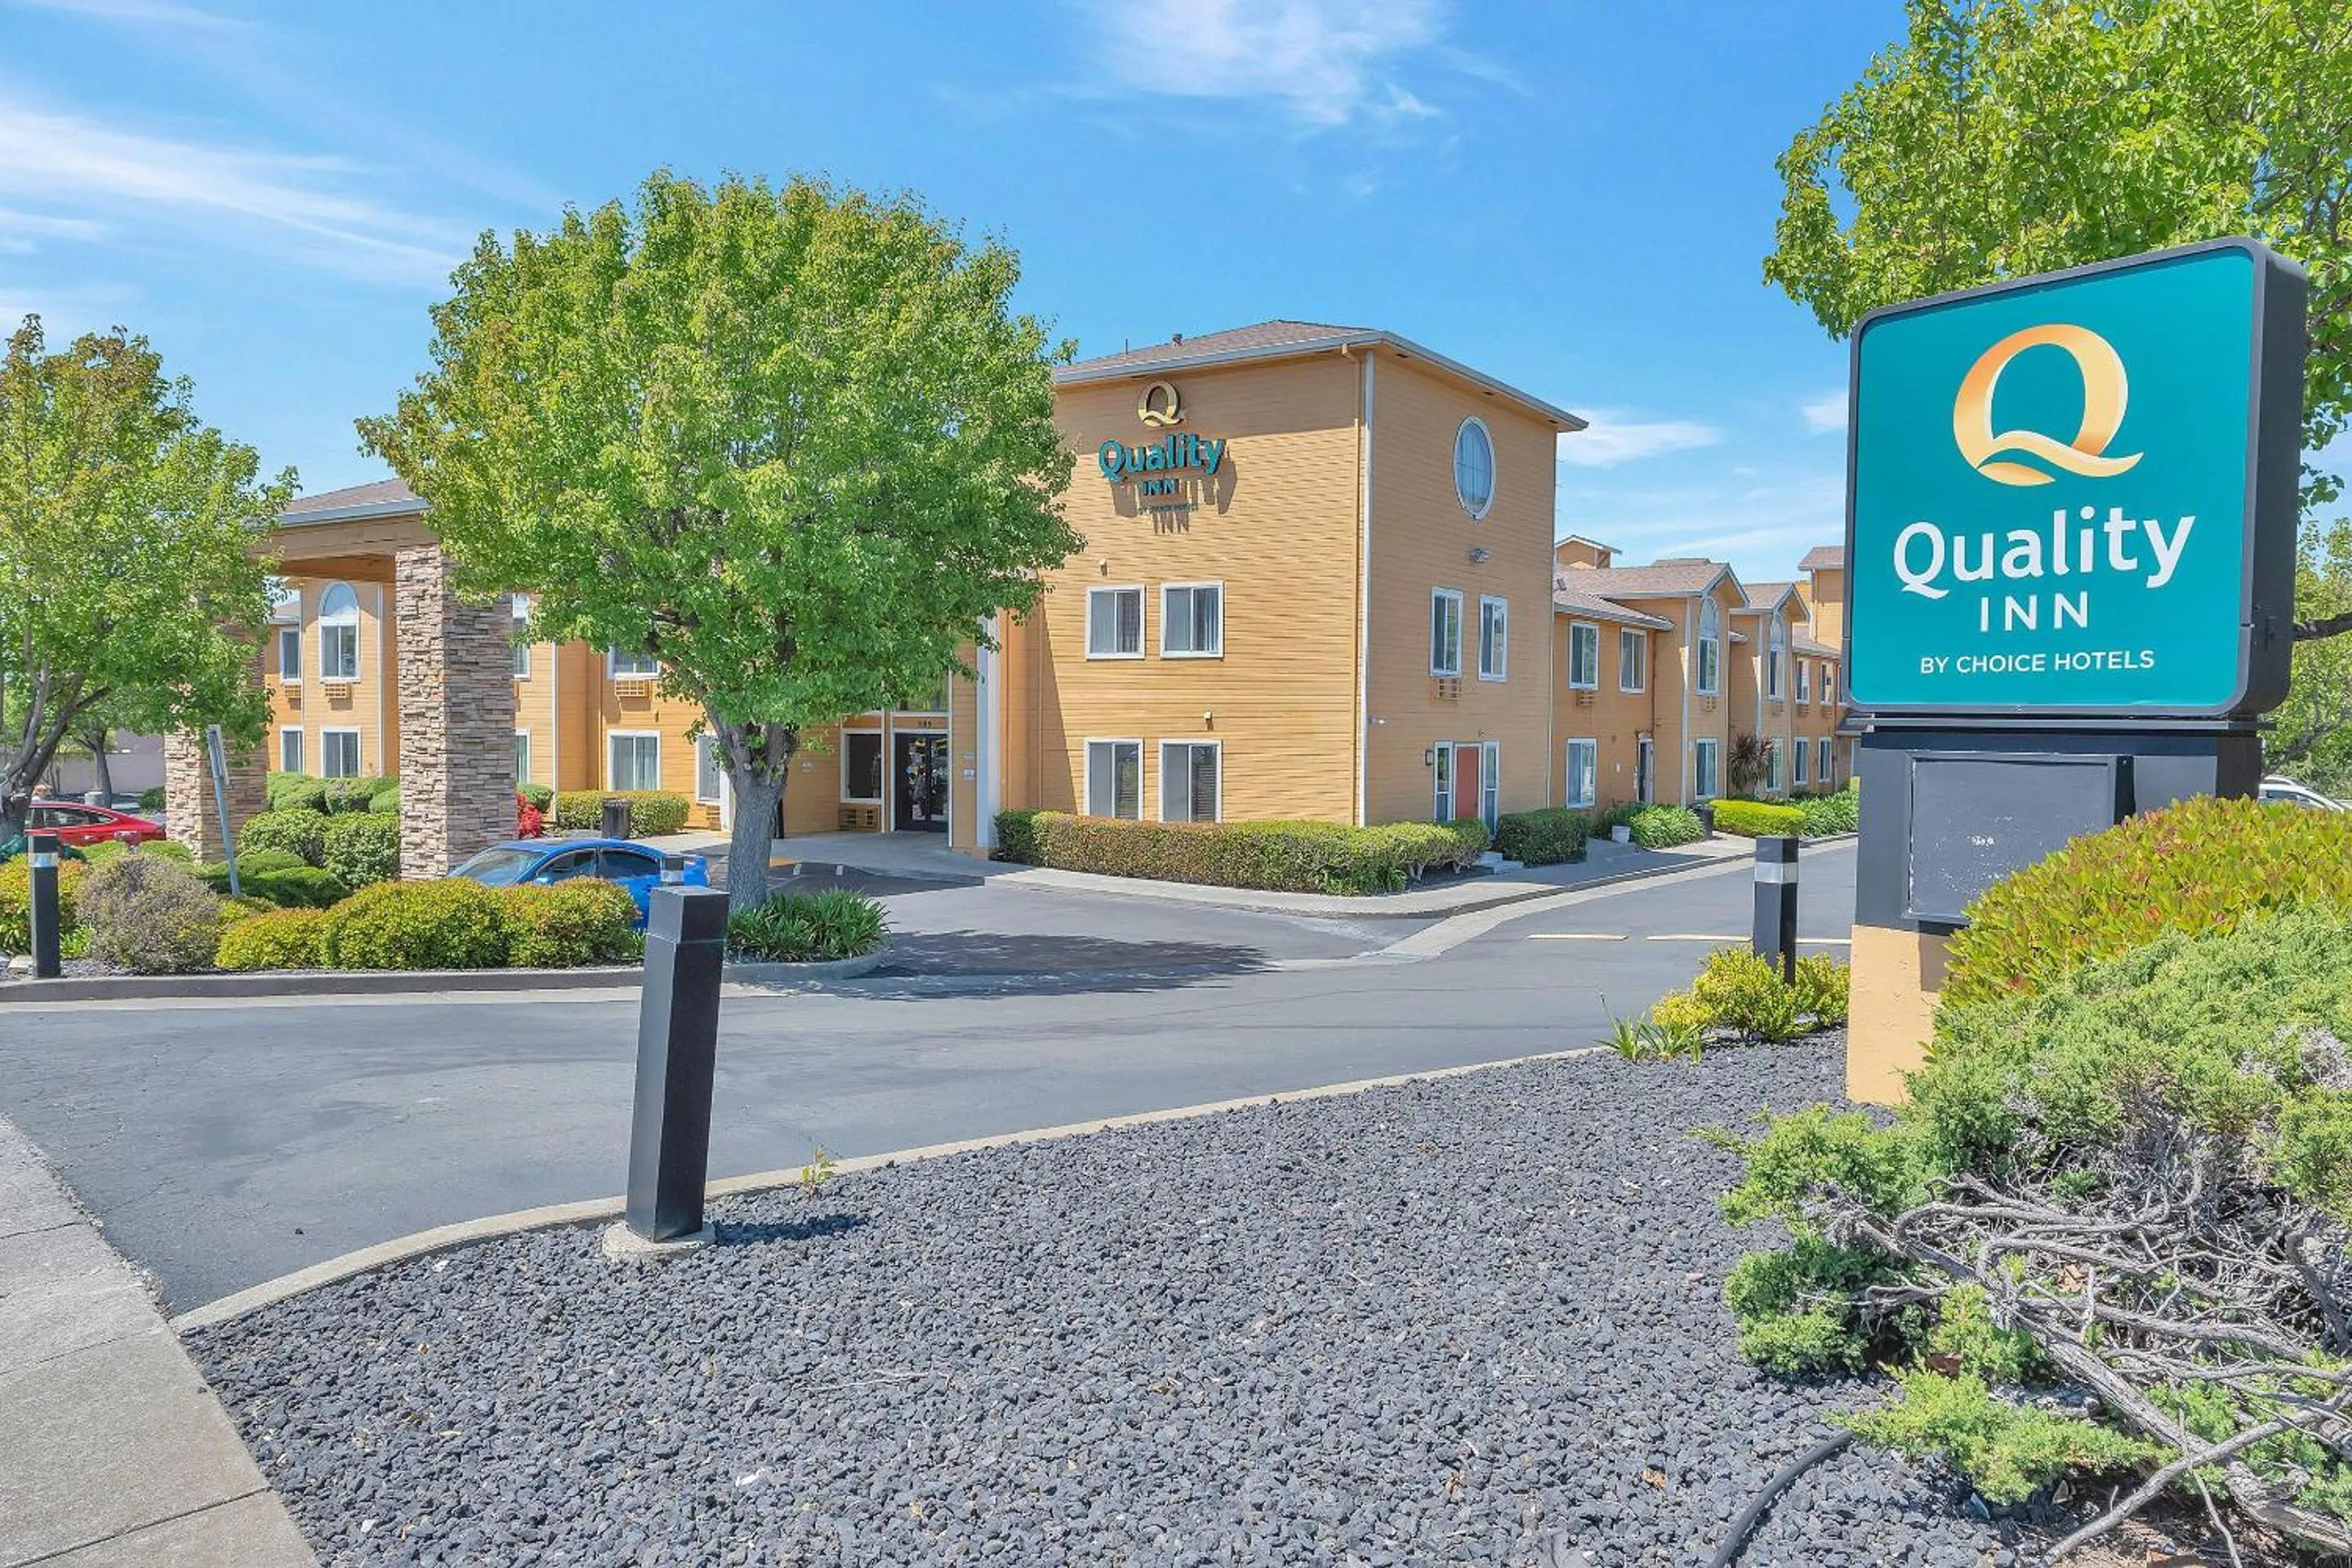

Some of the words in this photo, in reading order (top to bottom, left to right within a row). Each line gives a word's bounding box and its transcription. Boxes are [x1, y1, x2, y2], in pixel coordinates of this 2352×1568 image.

[1098, 432, 1226, 483] Quality
[1143, 479, 1178, 496] INN
[1894, 506, 2195, 599] Quality
[1980, 591, 2088, 633] INN
[1920, 657, 1949, 674] BY
[1956, 654, 2046, 674] CHOICE
[2054, 650, 2155, 671] HOTELS
